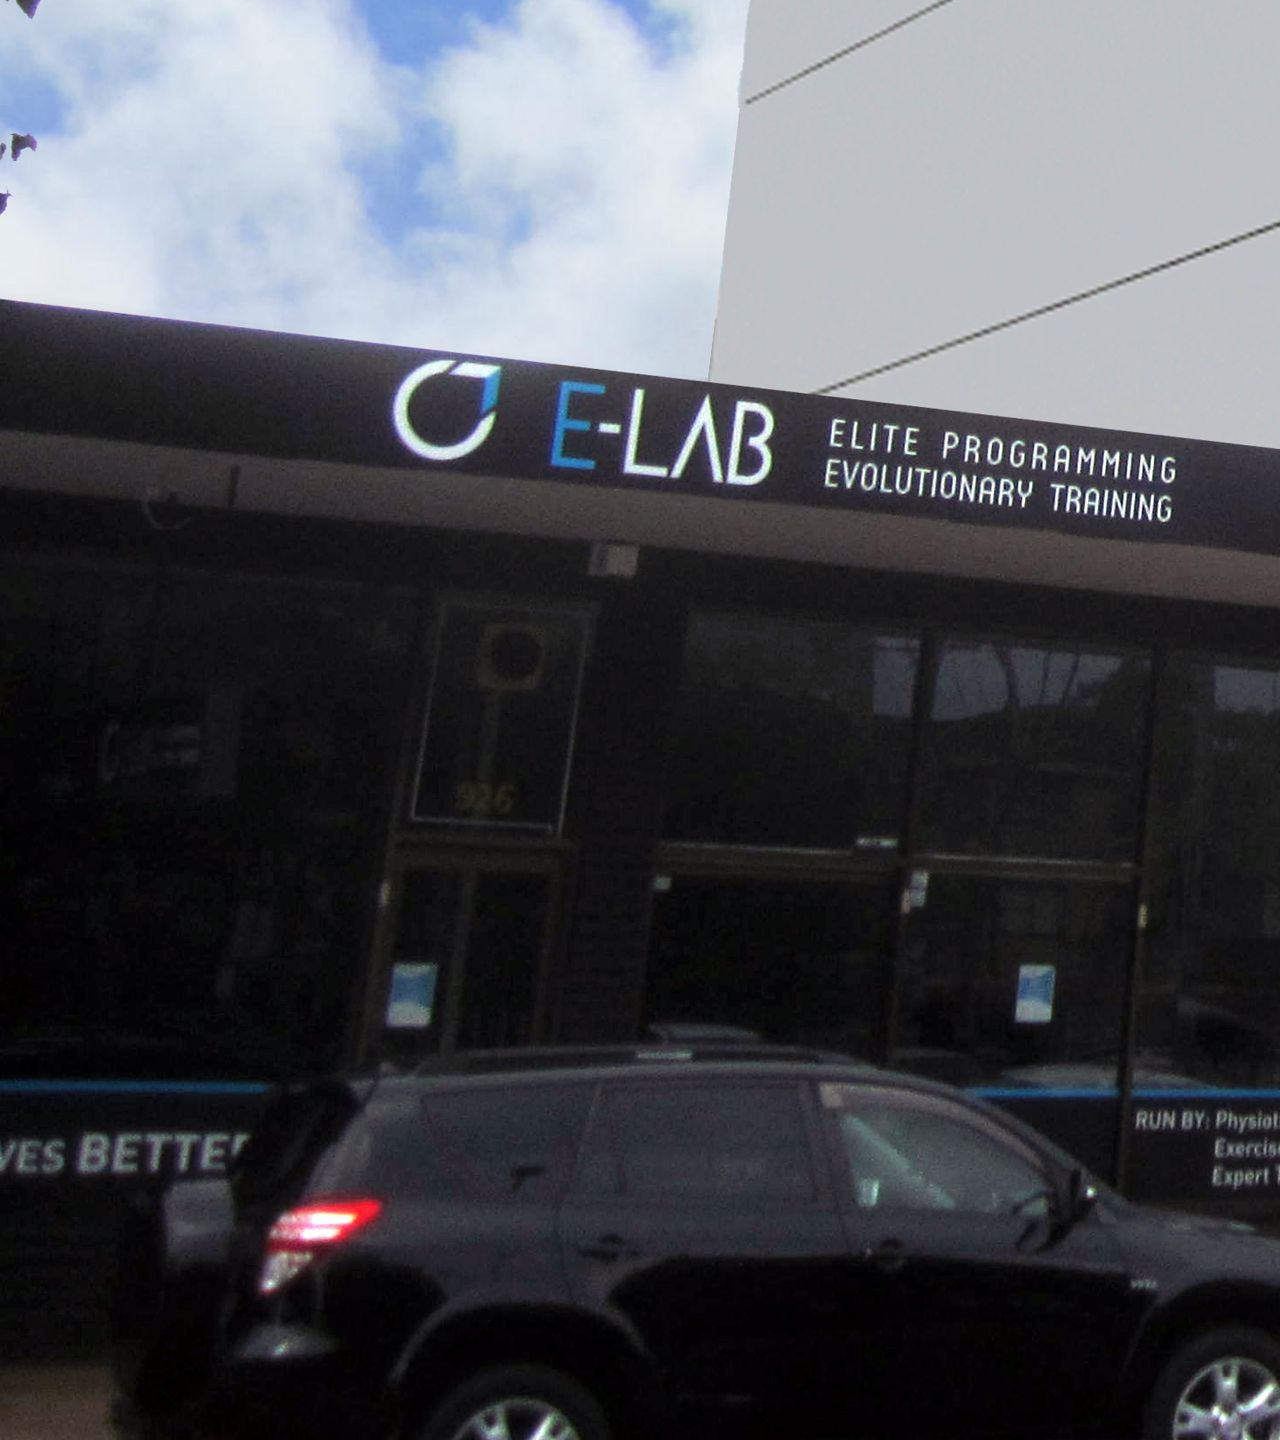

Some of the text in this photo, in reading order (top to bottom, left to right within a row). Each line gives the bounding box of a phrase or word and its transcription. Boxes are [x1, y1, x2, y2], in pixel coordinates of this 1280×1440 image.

[551, 380, 775, 487] E-LAB
[829, 418, 1178, 485] ELITE PROGRAMMING
[824, 458, 1174, 523] EVOLUTIONARY TRAINING
[1135, 1109, 1175, 1131] RUN
[1212, 1165, 1270, 1190] Expert
